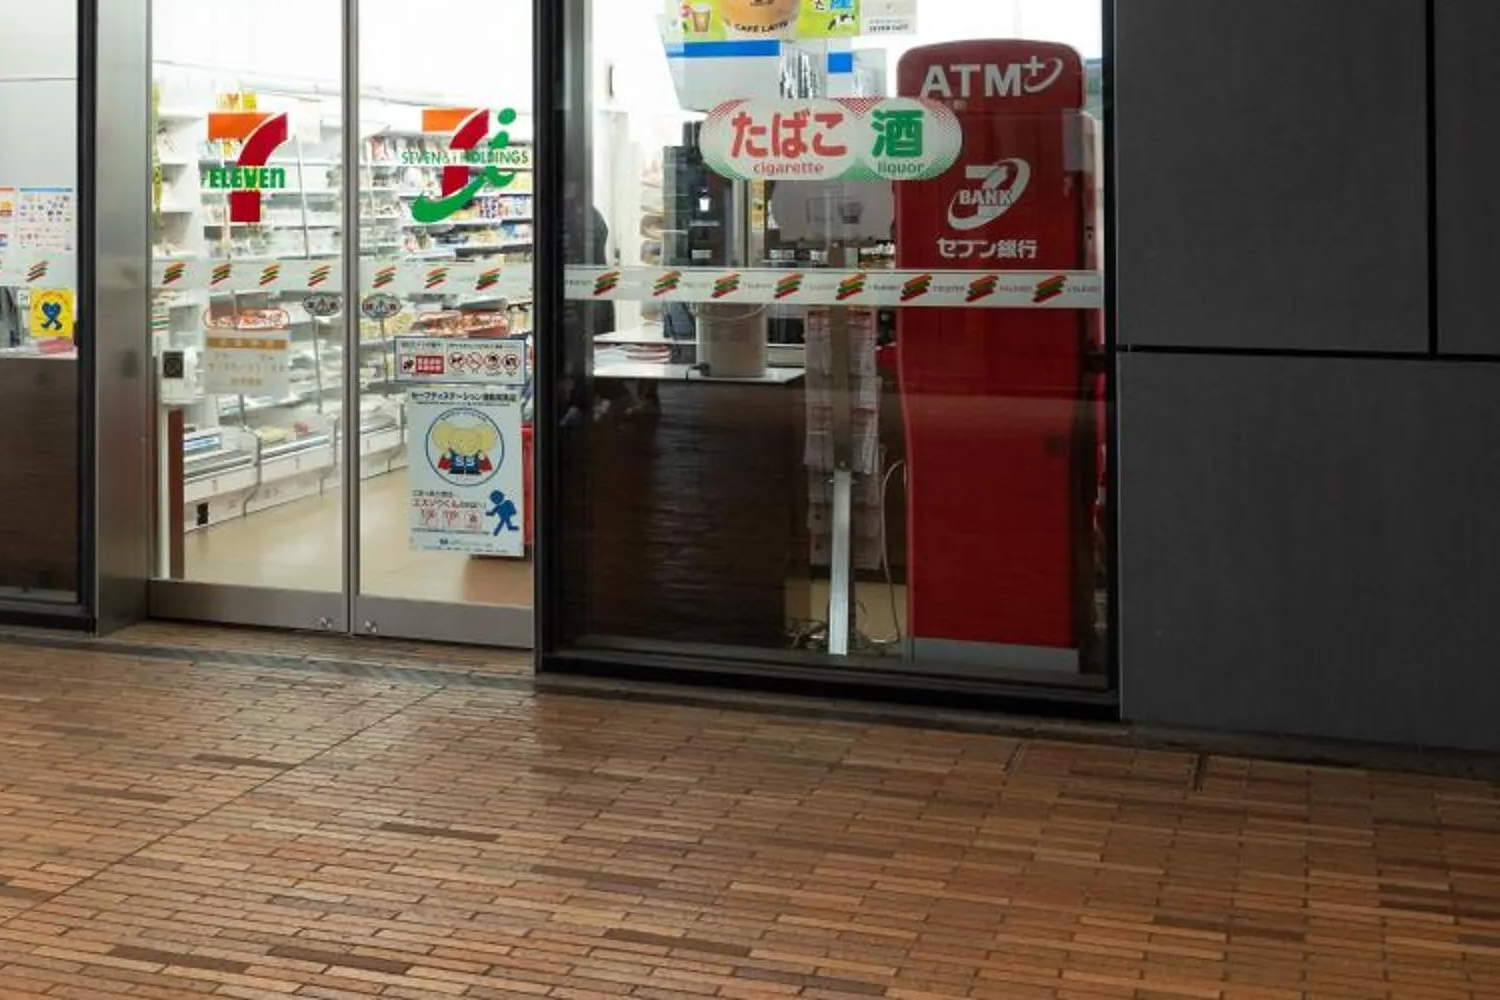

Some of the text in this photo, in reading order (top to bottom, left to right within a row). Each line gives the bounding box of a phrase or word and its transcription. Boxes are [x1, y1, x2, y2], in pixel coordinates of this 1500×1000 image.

[732, 109, 924, 158] たばこ 酒
[753, 161, 925, 176] cigarette liquor
[959, 189, 1013, 207] BANK
[936, 237, 1038, 260] セブン銀行
